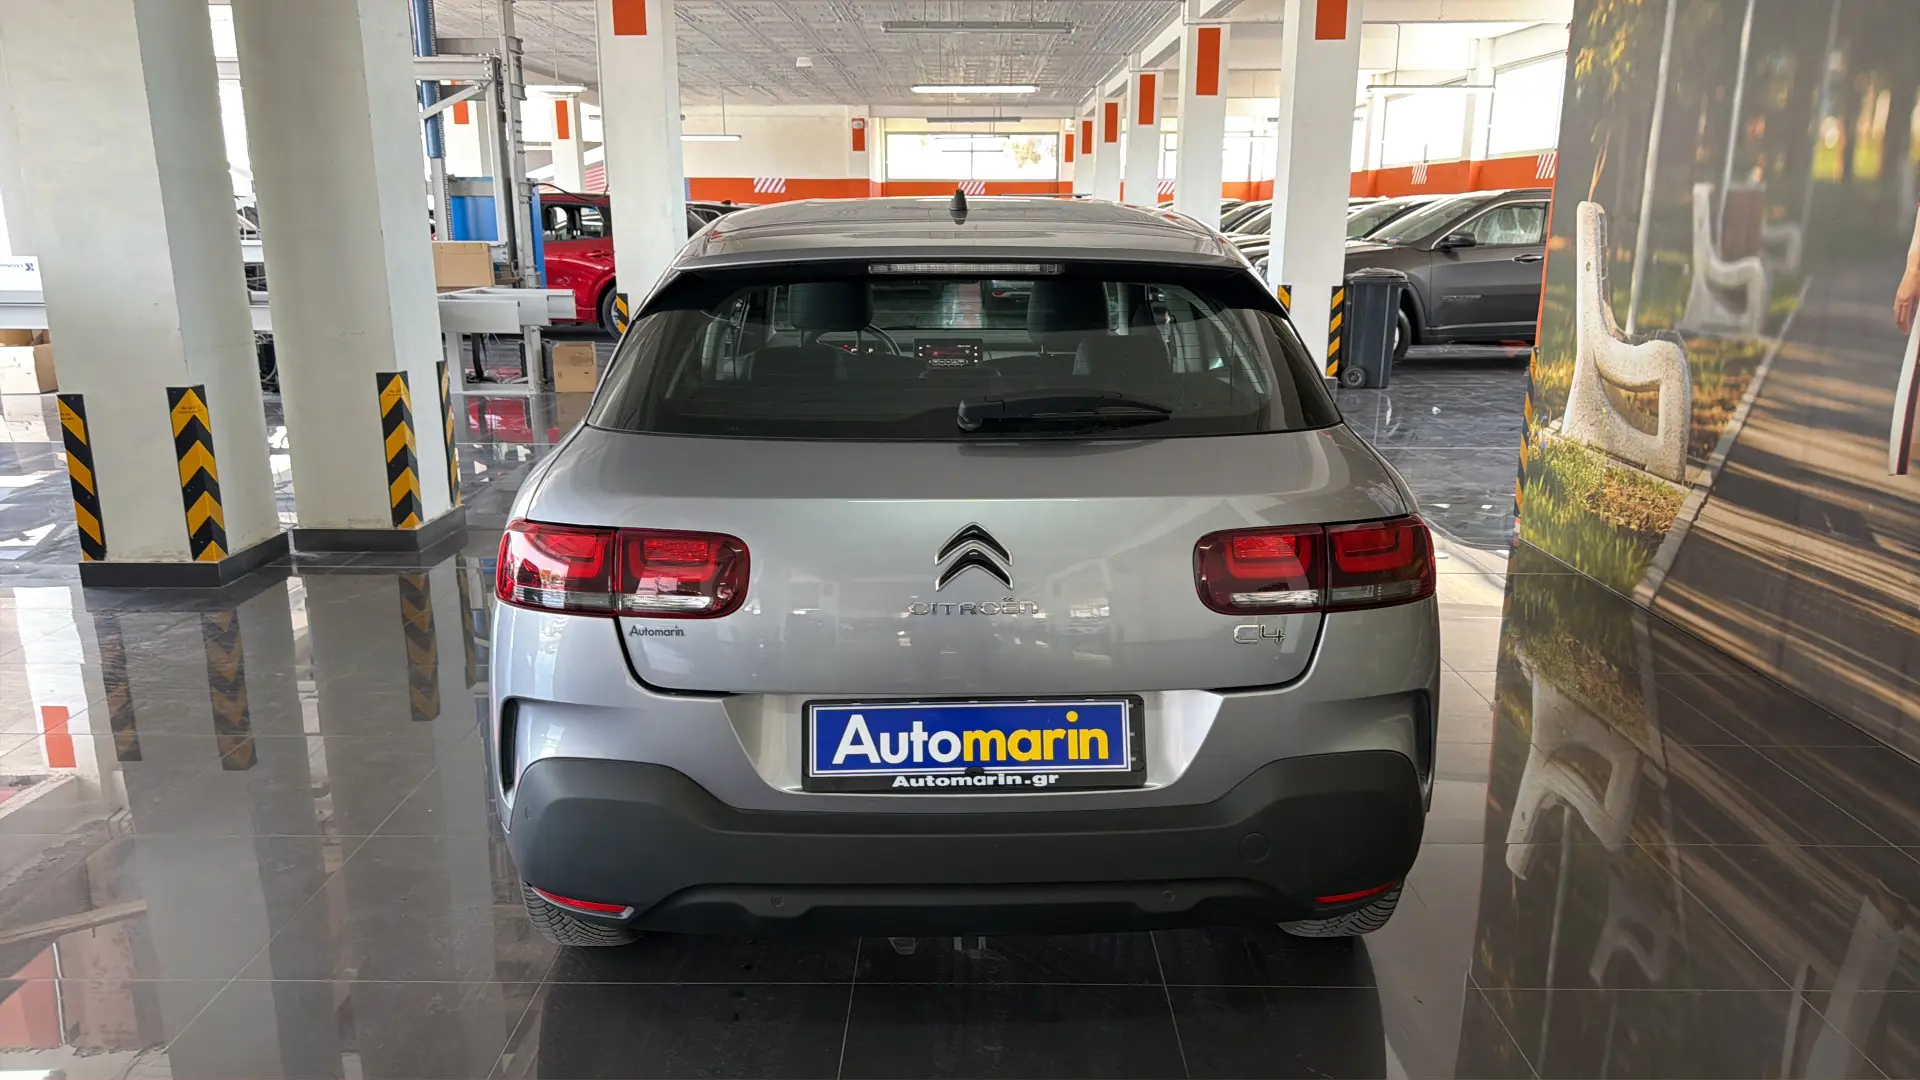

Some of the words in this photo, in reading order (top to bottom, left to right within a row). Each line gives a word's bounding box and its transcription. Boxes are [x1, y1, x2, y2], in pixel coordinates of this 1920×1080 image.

[628, 625, 685, 637] Automarin
[1233, 623, 1286, 645] C4
[832, 711, 1109, 764] Automarin
[892, 773, 1059, 788] Automarin.gr
